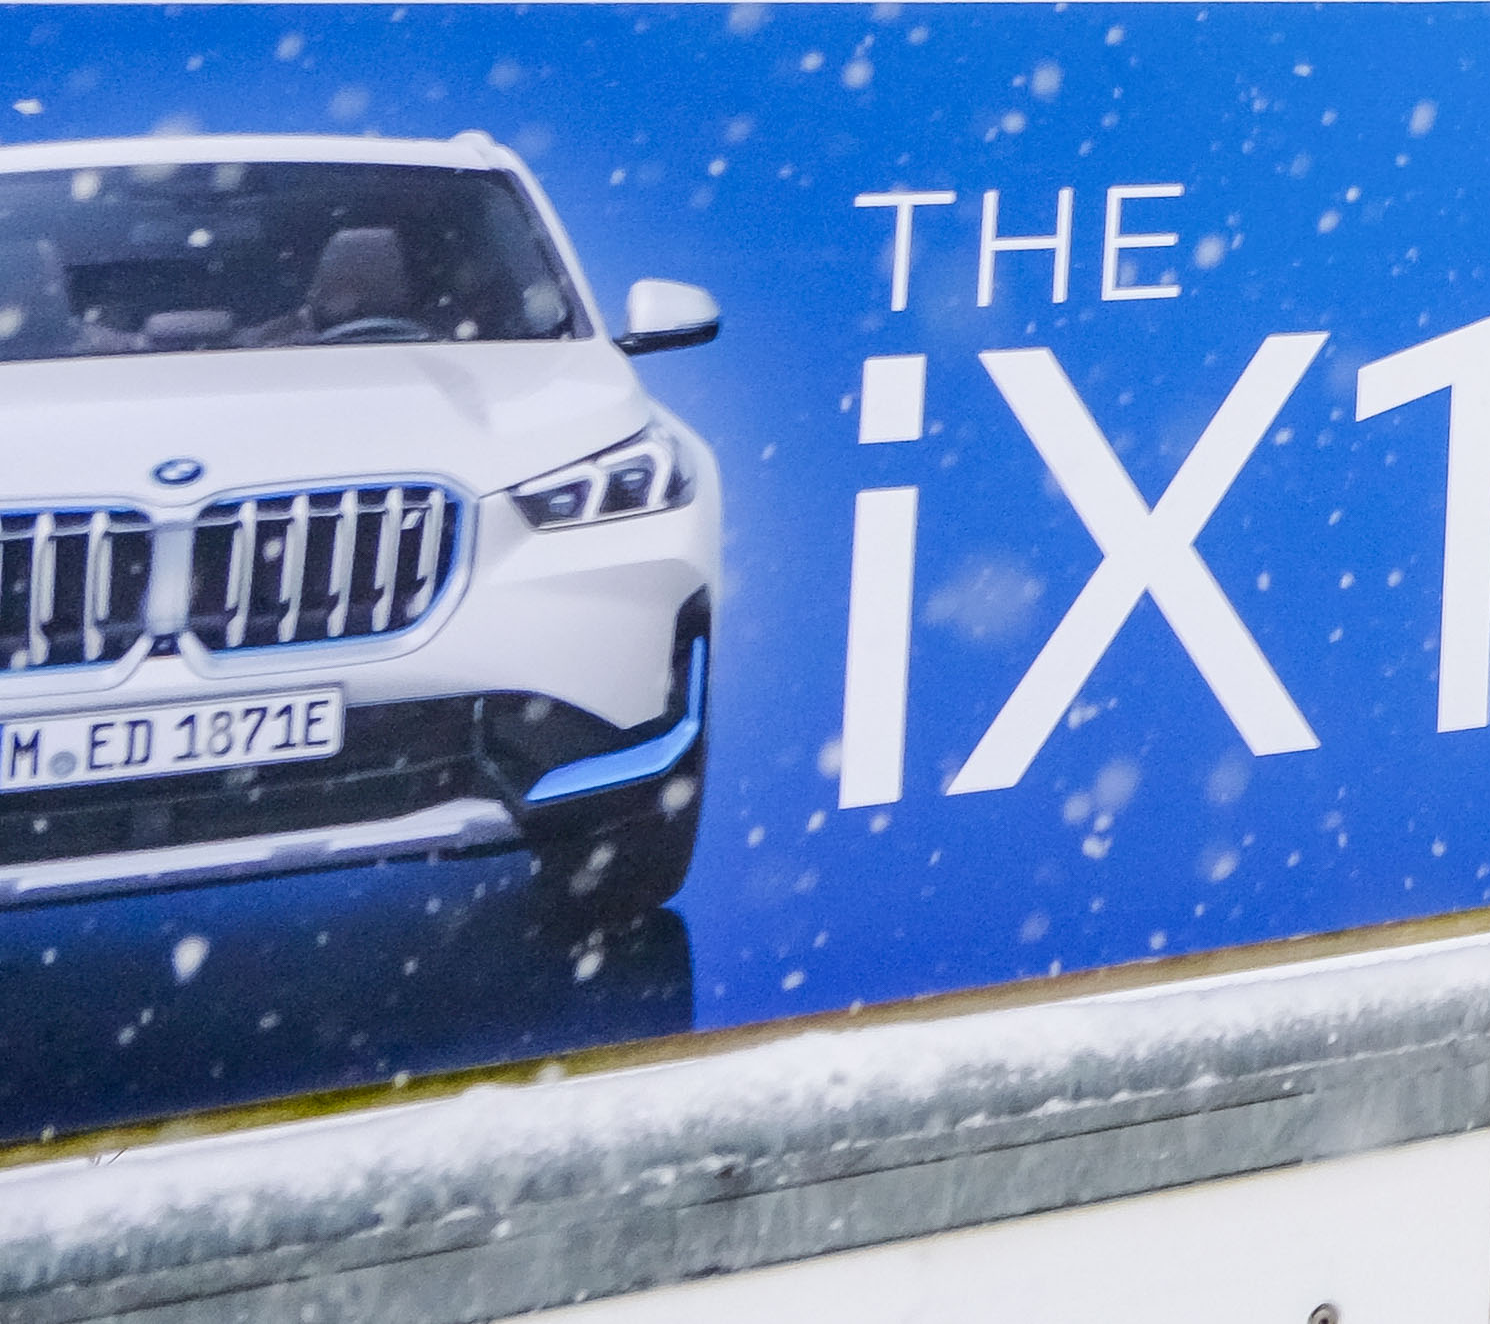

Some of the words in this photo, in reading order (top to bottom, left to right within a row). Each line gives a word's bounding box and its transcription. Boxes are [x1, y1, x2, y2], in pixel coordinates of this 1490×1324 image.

[854, 183, 1183, 311] THE
[10, 728, 41, 778] M
[88, 720, 153, 770] ED
[172, 700, 329, 762] 1871E
